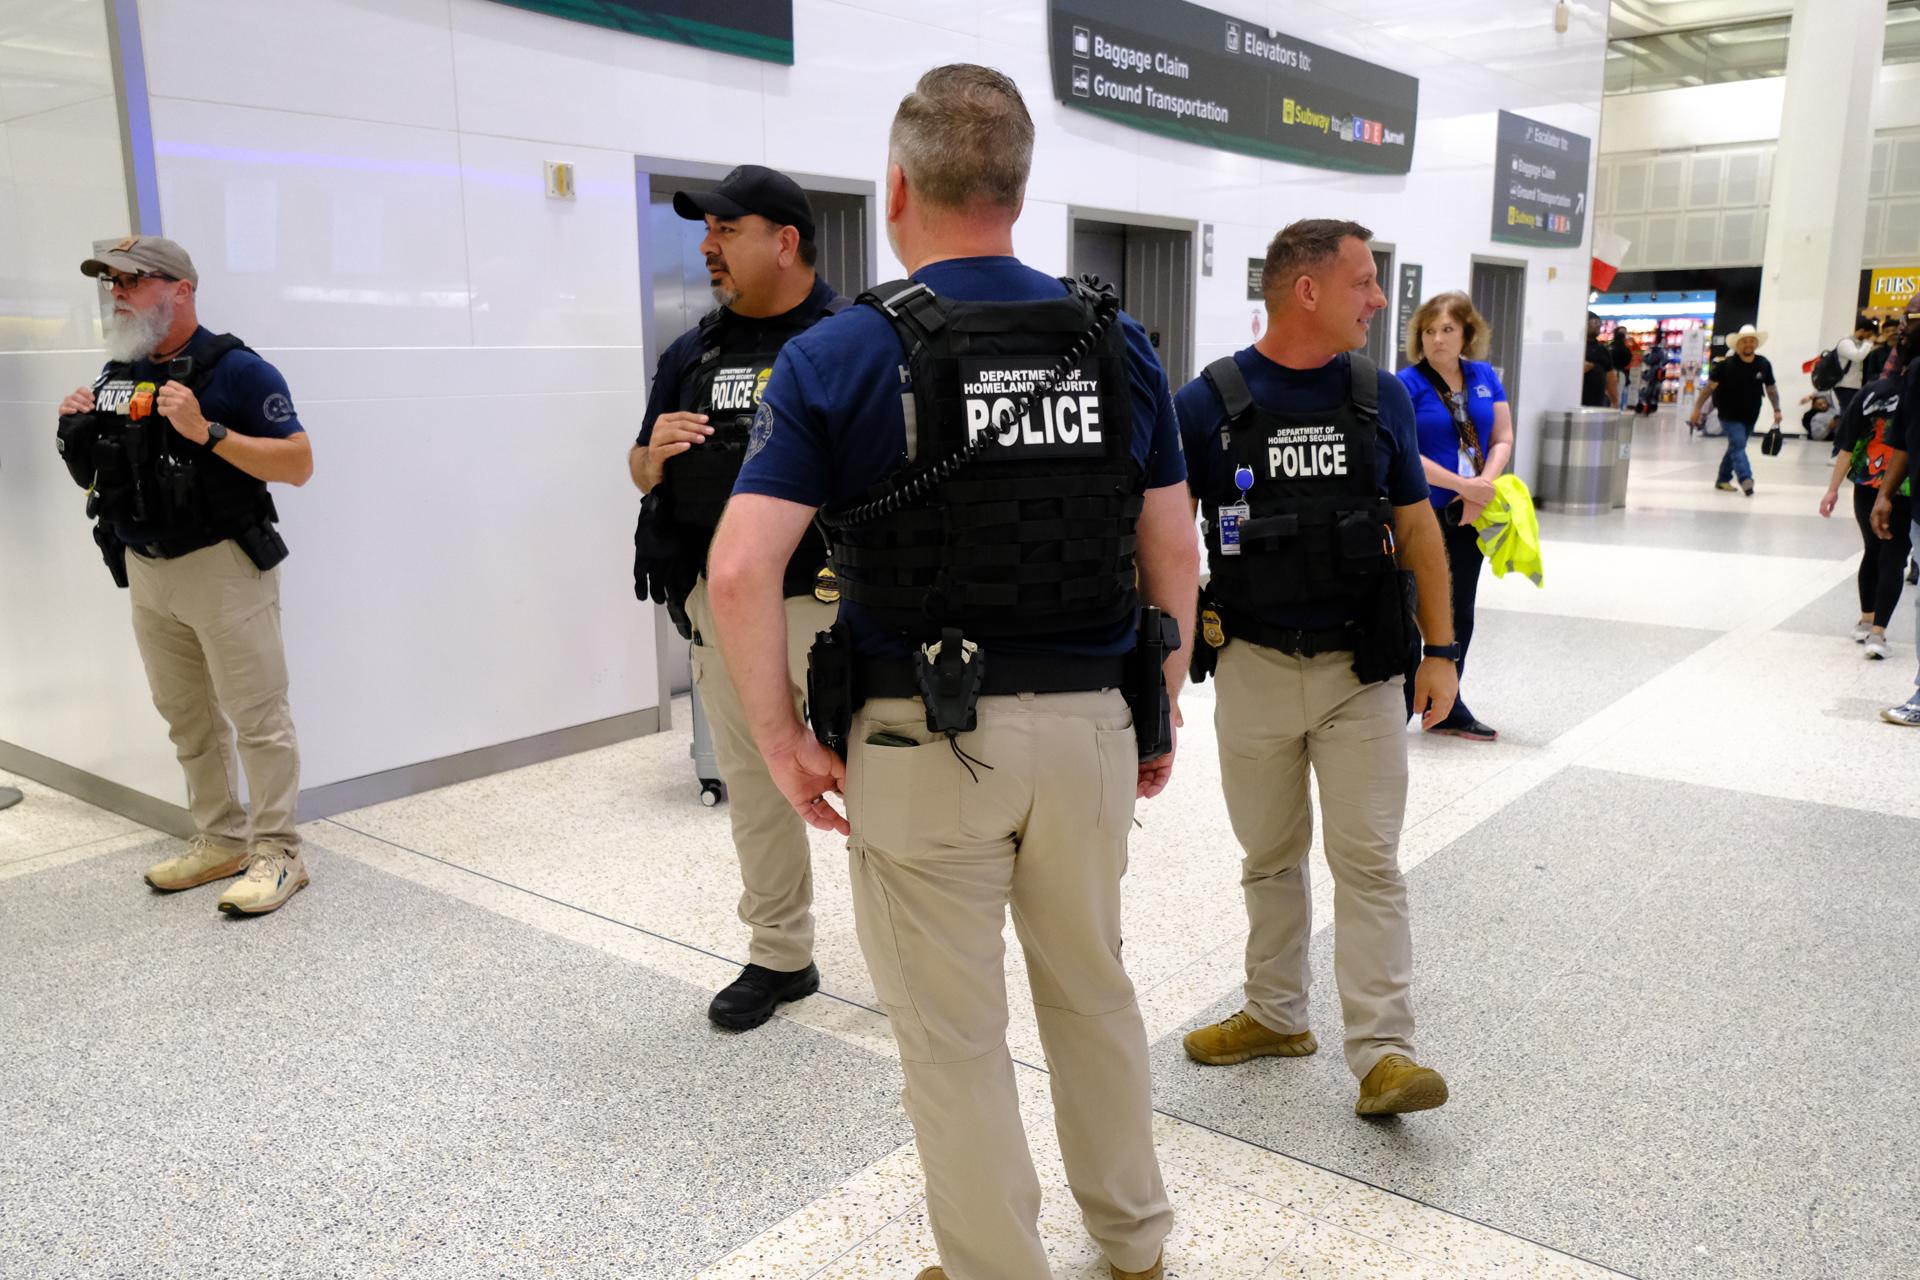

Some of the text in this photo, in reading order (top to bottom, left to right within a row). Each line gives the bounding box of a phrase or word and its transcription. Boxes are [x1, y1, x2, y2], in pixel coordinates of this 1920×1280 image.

[1094, 36, 1189, 79] Baggage Claim
[1244, 31, 1311, 72] Elevators to:
[1094, 75, 1229, 123] Ground Transportation
[1295, 105, 1330, 134] Subway
[1354, 120, 1361, 138] C
[1364, 122, 1370, 140] D
[1407, 280, 1414, 298] 2
[711, 380, 754, 411] POLICE
[964, 381, 1035, 394] HOMELAND
[966, 395, 1102, 448] POLICE
[1268, 433, 1345, 445] HOMELAND SECURITY
[1277, 426, 1335, 437] DEPARTMENT OF
[1268, 443, 1347, 478] POLICE
